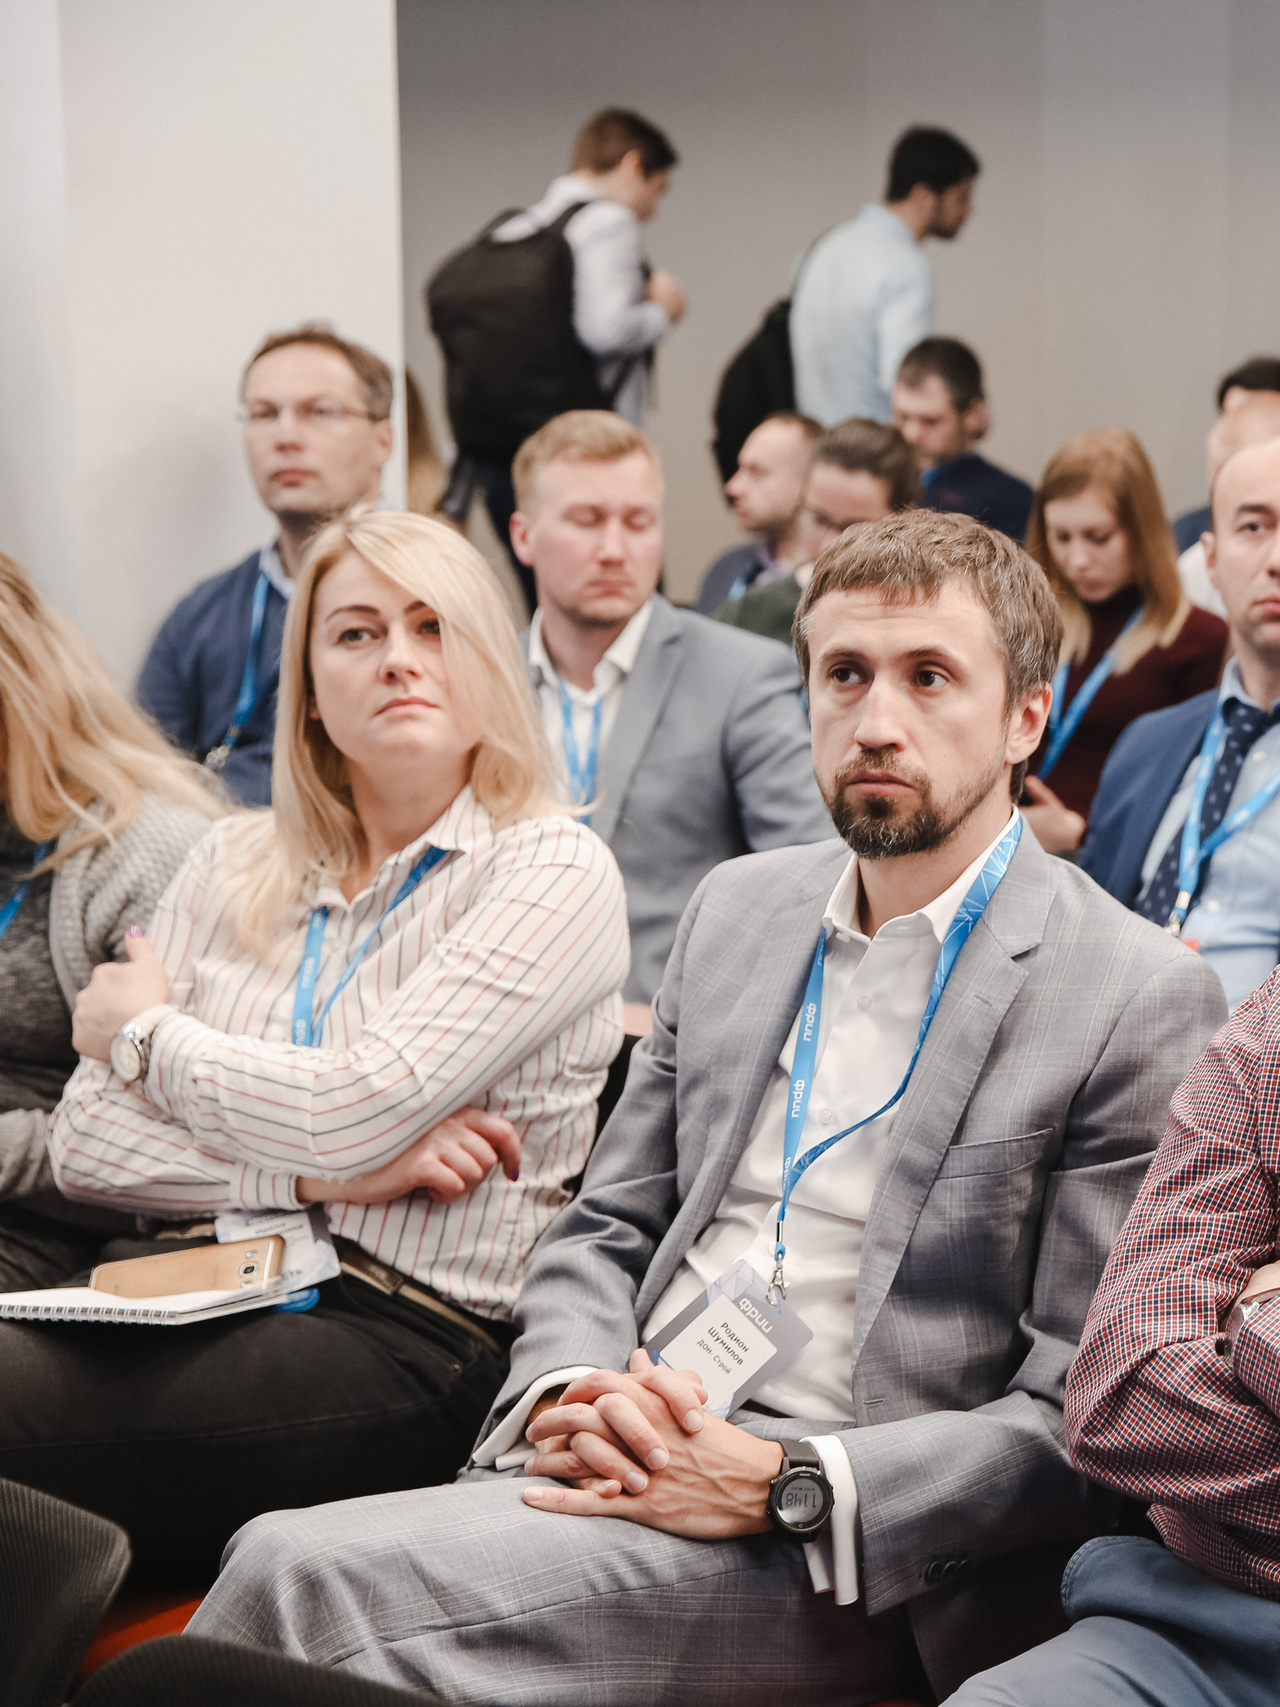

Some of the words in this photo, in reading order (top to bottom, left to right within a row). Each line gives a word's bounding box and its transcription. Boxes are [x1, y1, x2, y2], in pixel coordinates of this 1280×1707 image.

[707, 1326, 744, 1366] Шумилов
[720, 1321, 749, 1353] Родион
[713, 1355, 732, 1374] Строй
